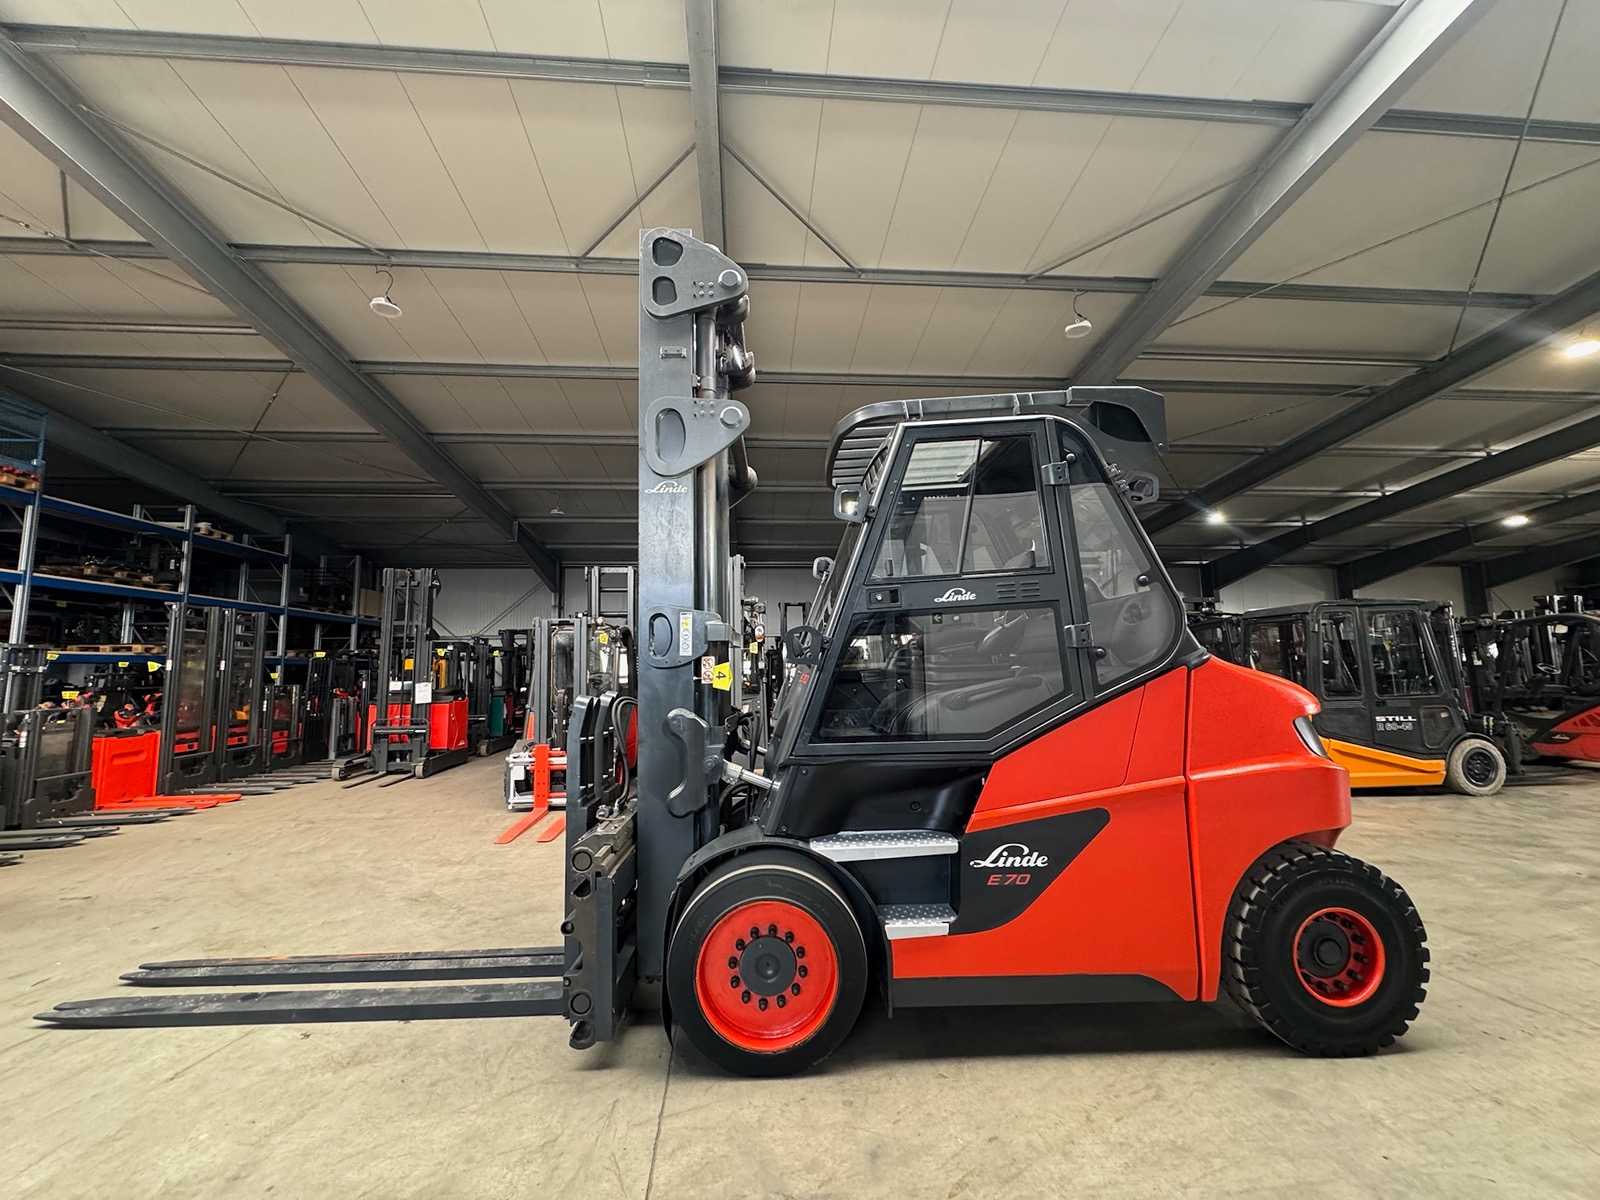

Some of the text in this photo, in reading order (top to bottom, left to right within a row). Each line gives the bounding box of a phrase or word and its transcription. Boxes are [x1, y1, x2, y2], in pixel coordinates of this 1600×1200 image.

[644, 480, 688, 493] Linde
[933, 587, 977, 602] Linde
[969, 843, 1049, 868] Linde
[987, 874, 1031, 886] E 70
